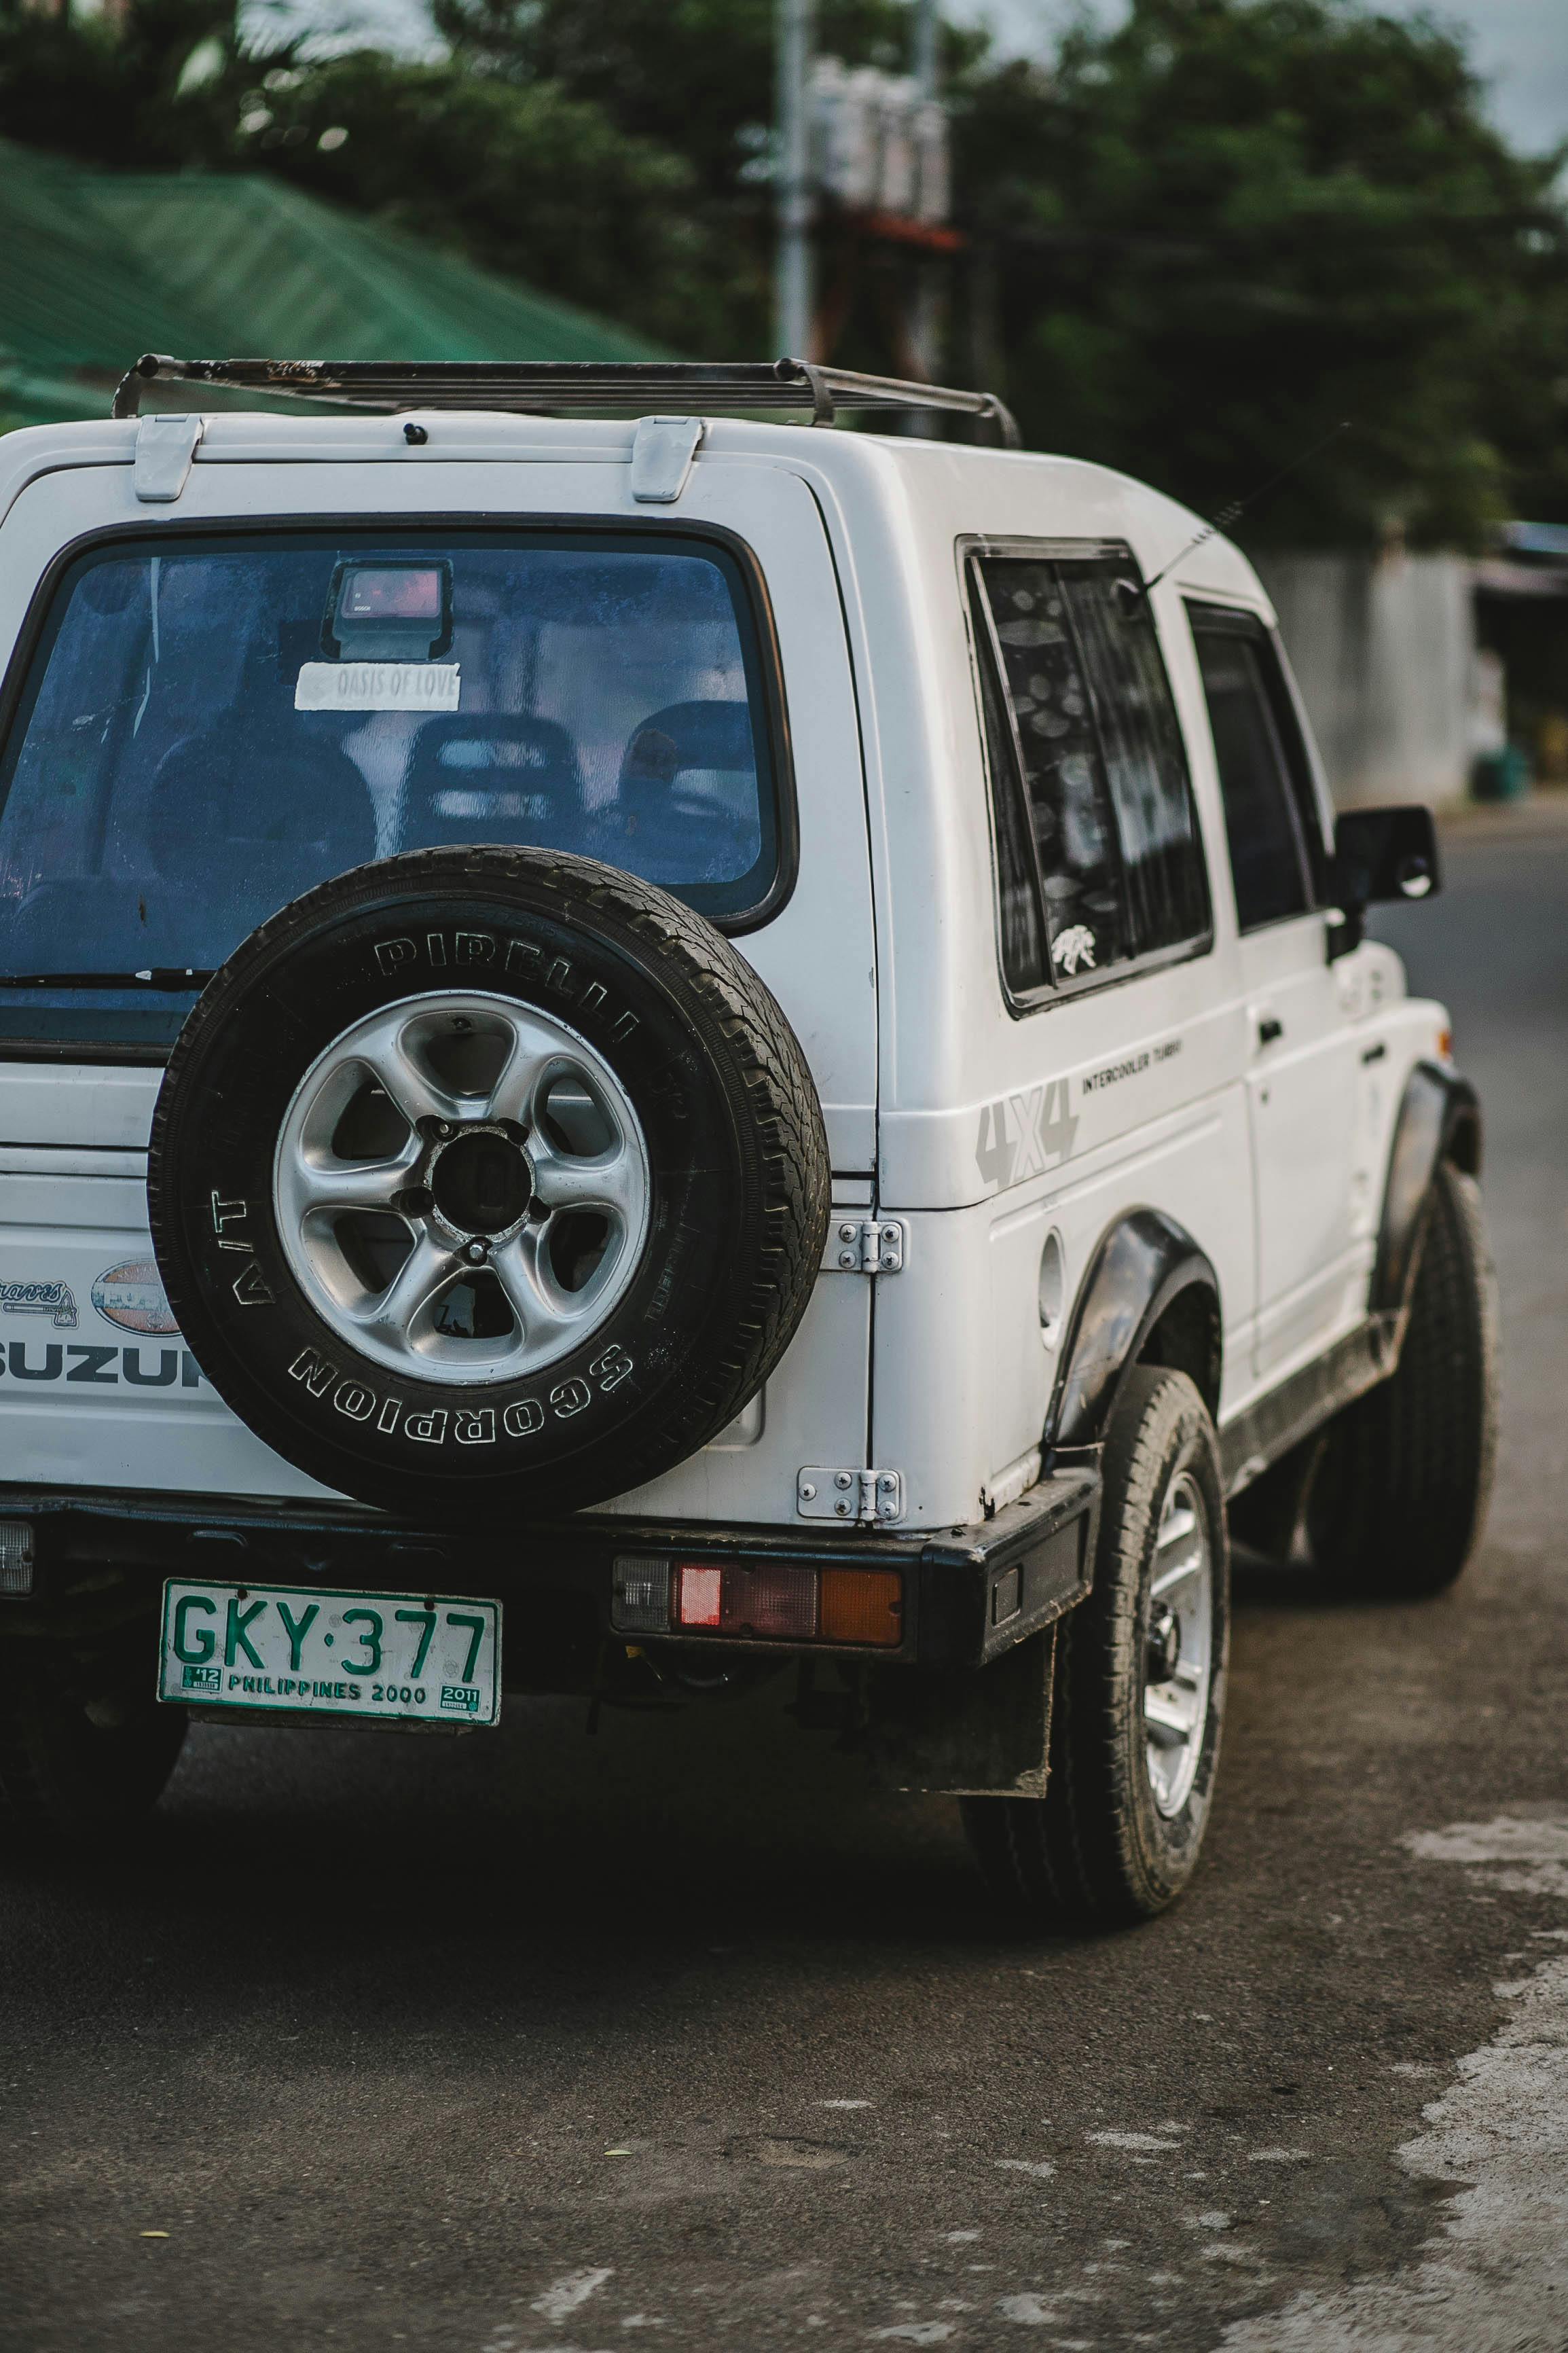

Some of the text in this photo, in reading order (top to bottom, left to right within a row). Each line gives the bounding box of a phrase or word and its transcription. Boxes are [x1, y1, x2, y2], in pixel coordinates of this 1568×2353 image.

[339, 668, 456, 698] OASIS OF LOVE
[374, 932, 640, 1041] PIRELLI
[1083, 1052, 1150, 1095] INTERCOOLER
[211, 1191, 276, 1305] A/T
[0, 1342, 208, 1387] UZU
[289, 1346, 634, 1445] SCORPION
[228, 1674, 426, 1704] PHILIPPINES 2000
[443, 1687, 477, 1702] 2011
